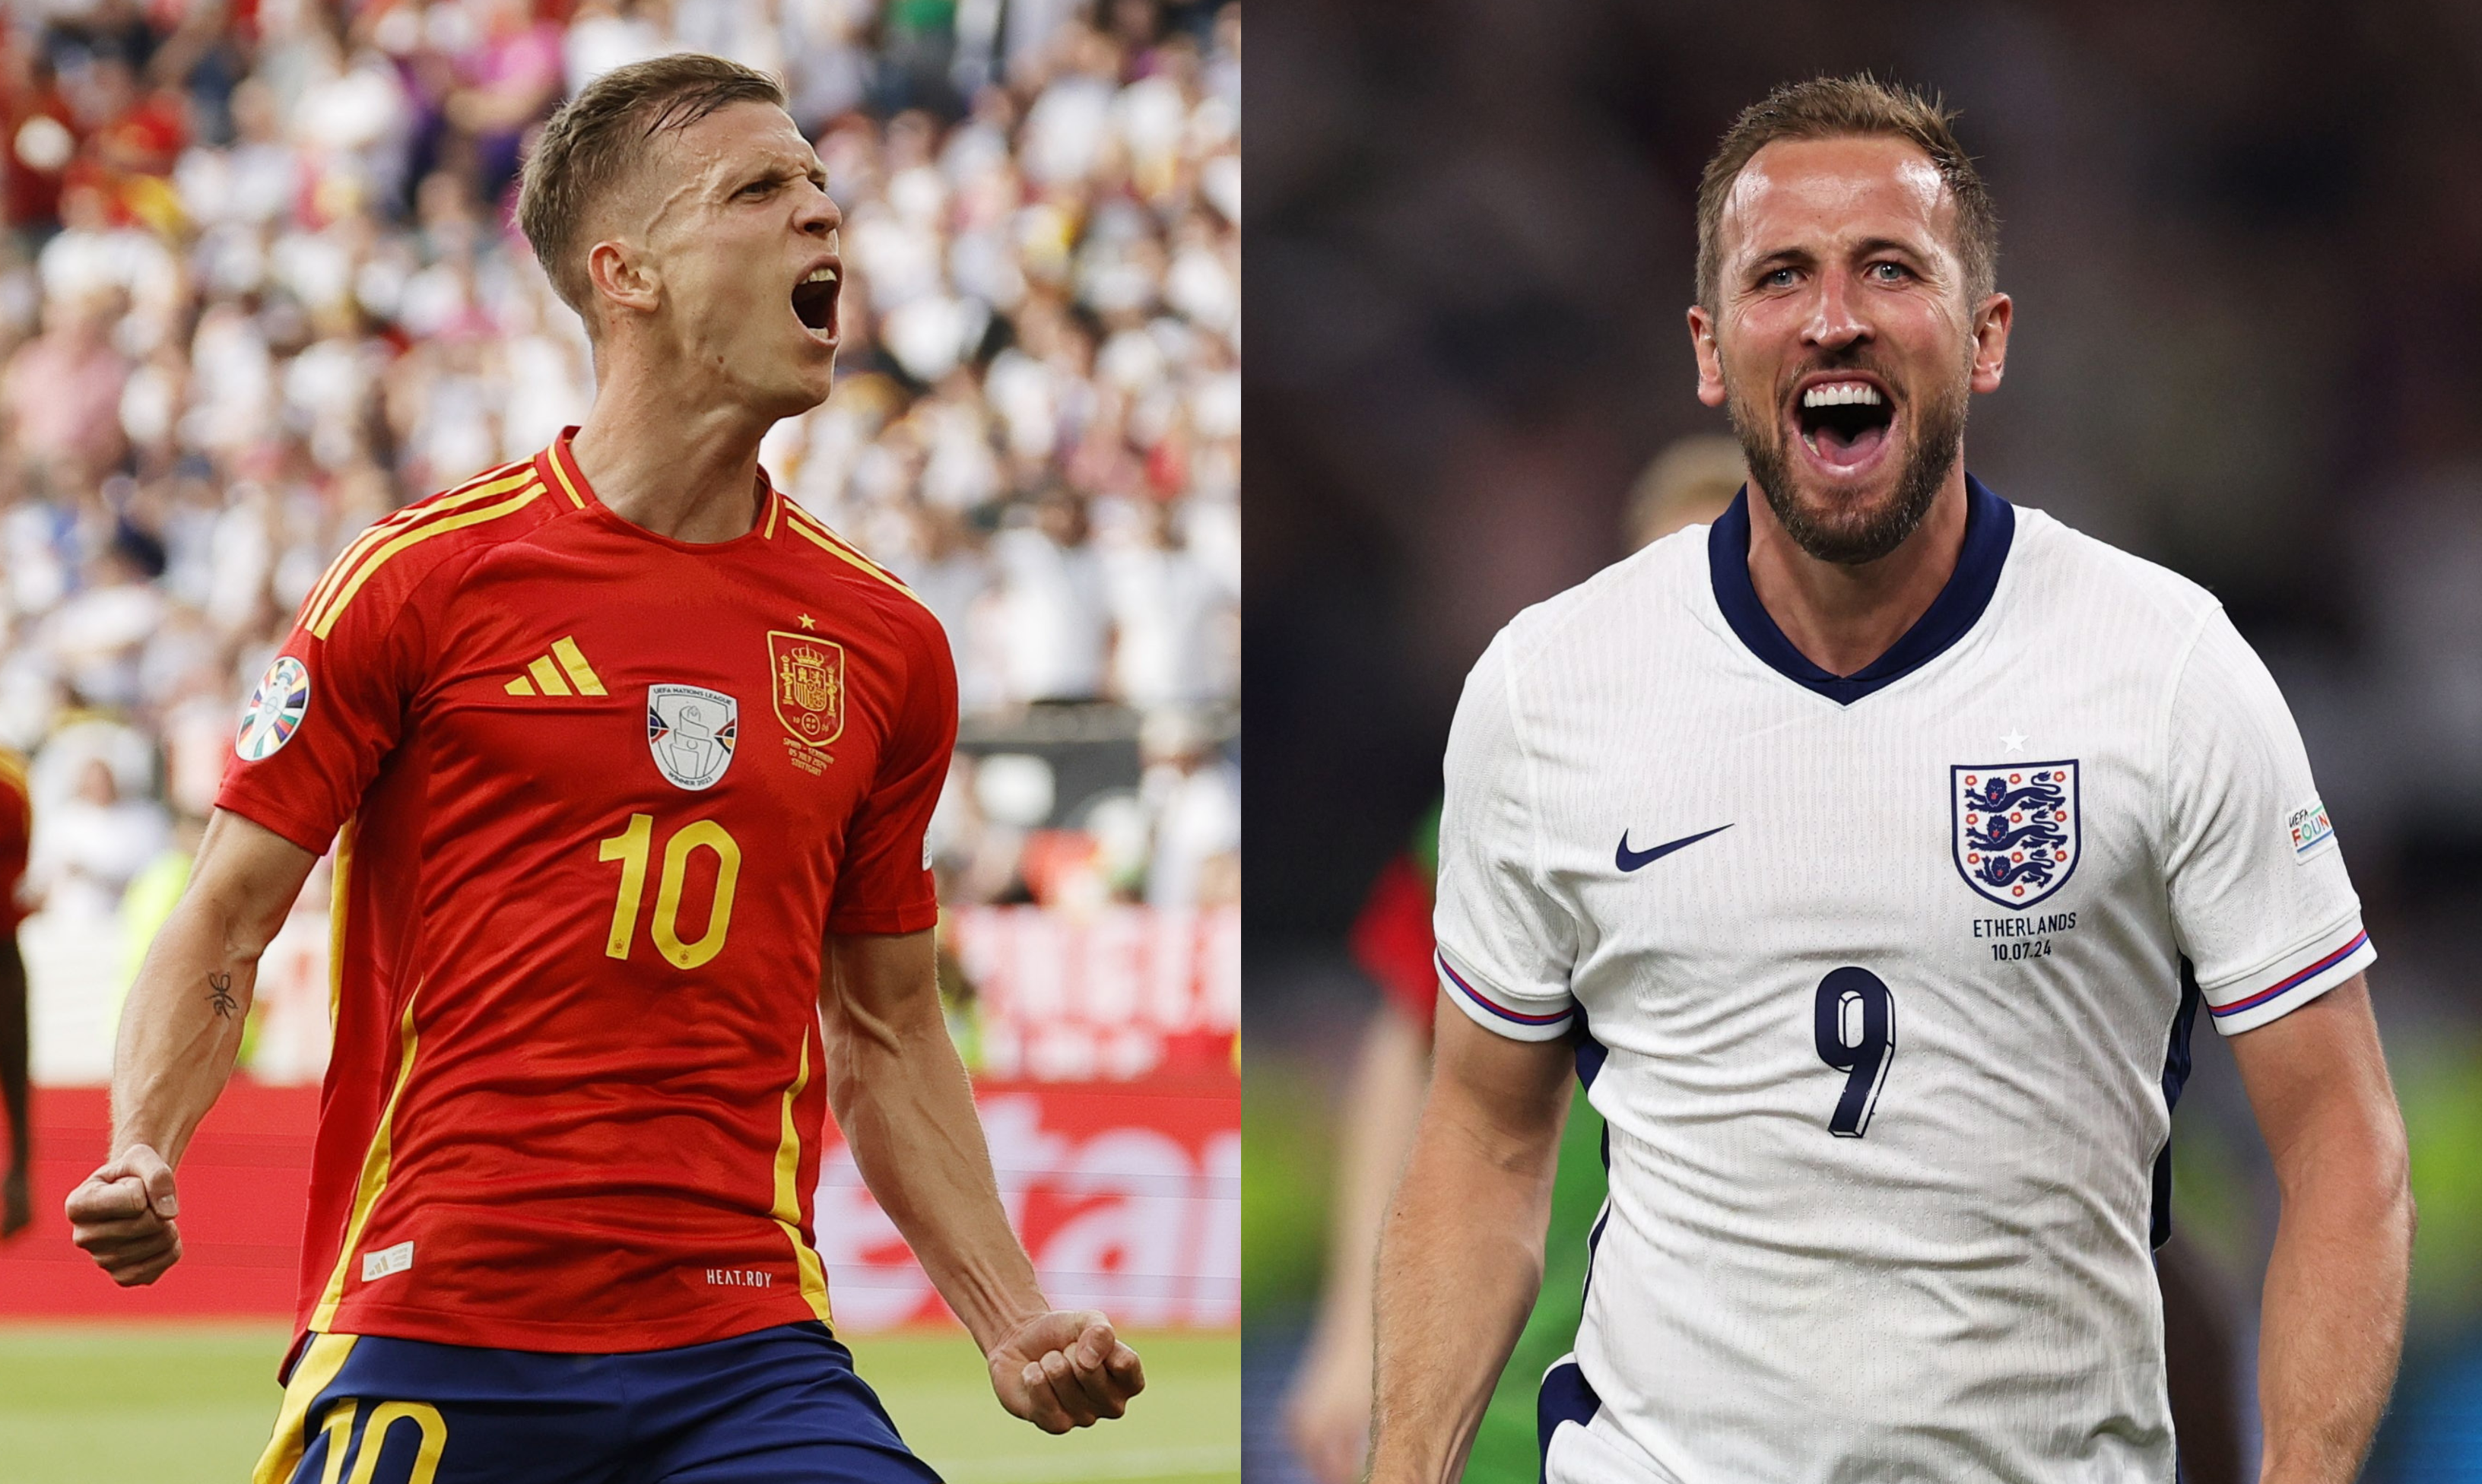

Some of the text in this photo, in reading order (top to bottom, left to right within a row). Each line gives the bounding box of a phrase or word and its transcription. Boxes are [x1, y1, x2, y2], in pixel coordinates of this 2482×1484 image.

[673, 687, 704, 696] NATIONS
[705, 691, 732, 706] LEAGUE
[2288, 808, 2309, 829] UEFA
[598, 813, 742, 970] 10
[1973, 912, 2077, 938] ETHERLANDS
[1991, 940, 2052, 962] 10.07.24
[1814, 966, 1896, 1138] 9
[319, 1397, 448, 1484] 10
